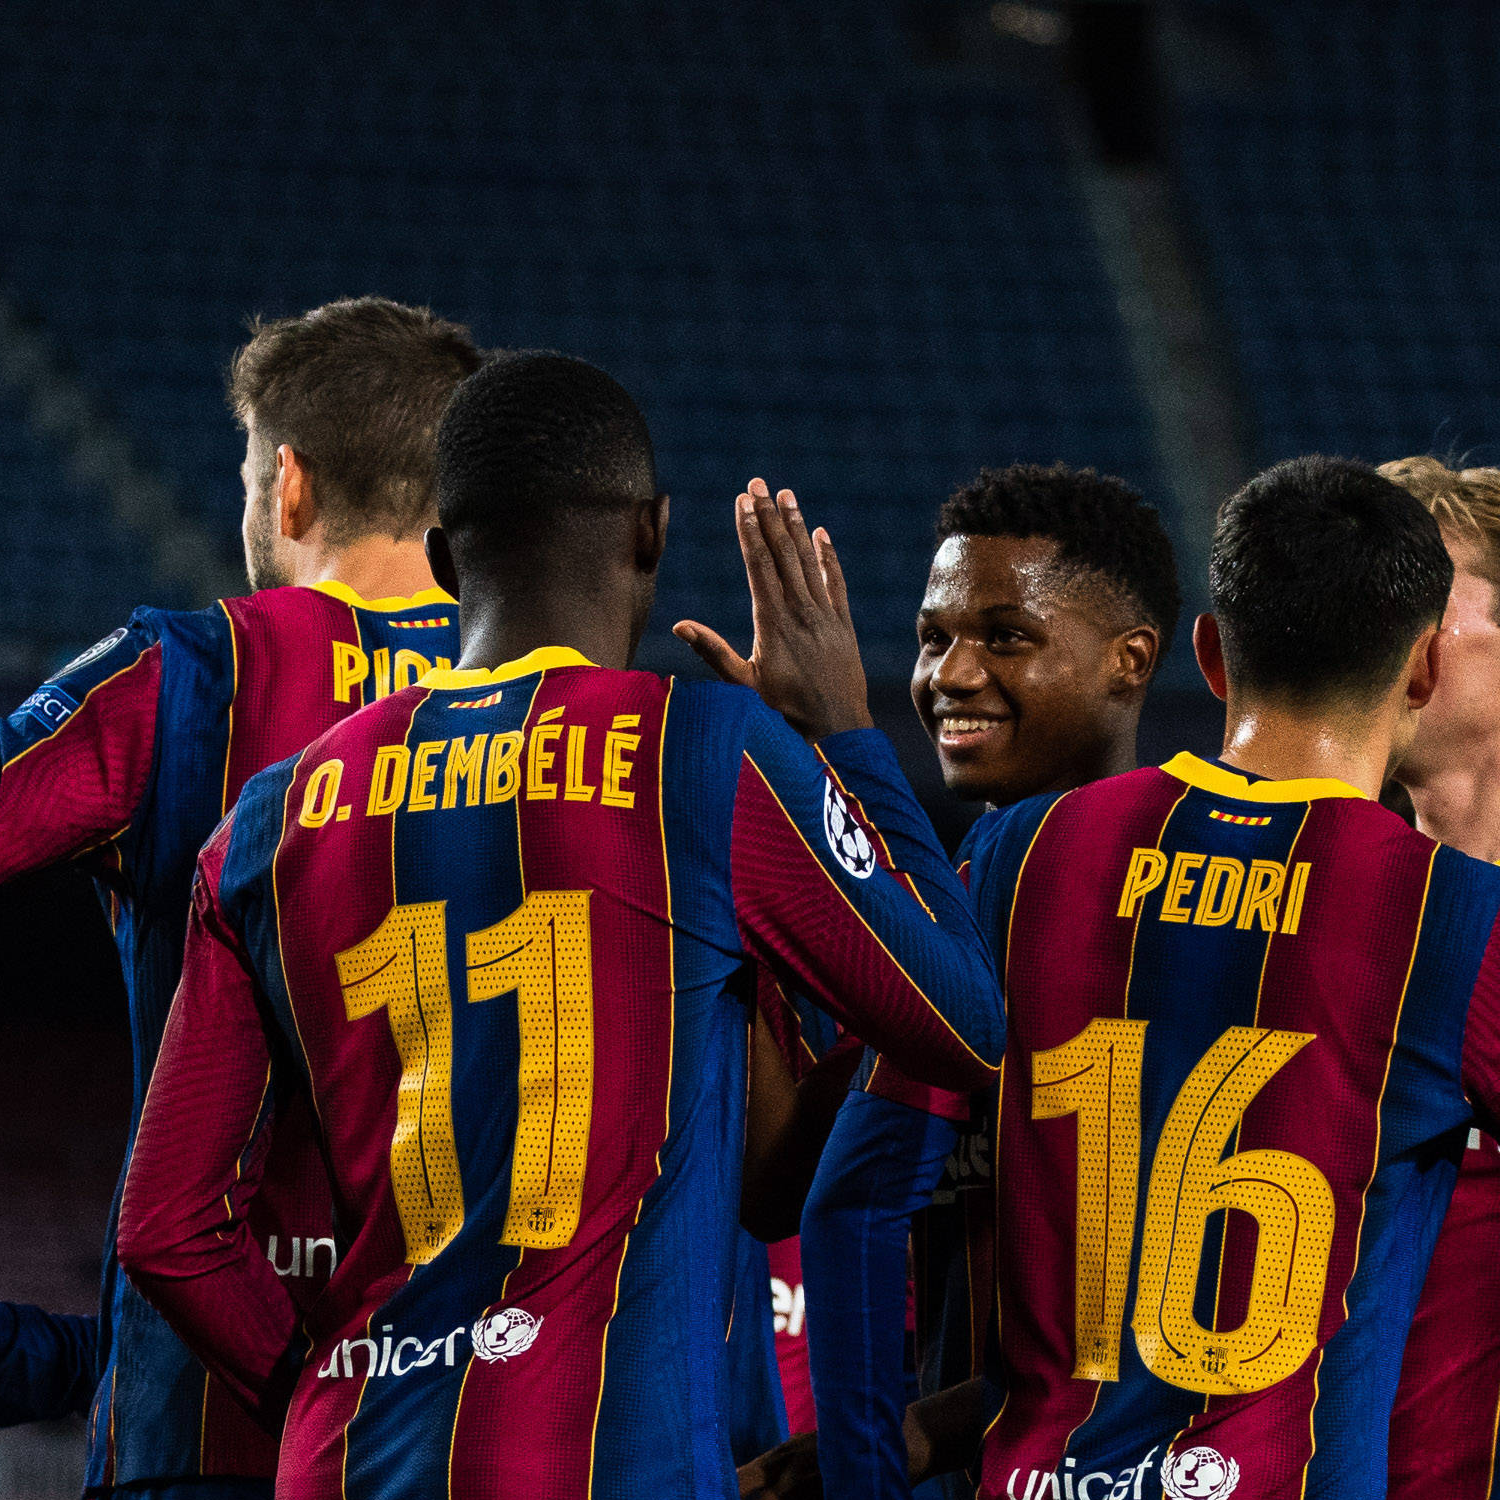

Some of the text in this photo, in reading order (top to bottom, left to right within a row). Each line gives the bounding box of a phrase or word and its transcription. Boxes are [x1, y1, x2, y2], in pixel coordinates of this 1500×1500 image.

[332, 640, 452, 703] PIQ
[298, 705, 641, 828] O. DEMBÉLÉ
[1116, 844, 1313, 937] PEDRI
[334, 889, 594, 1264] 11
[1031, 1017, 1337, 1396] 16
